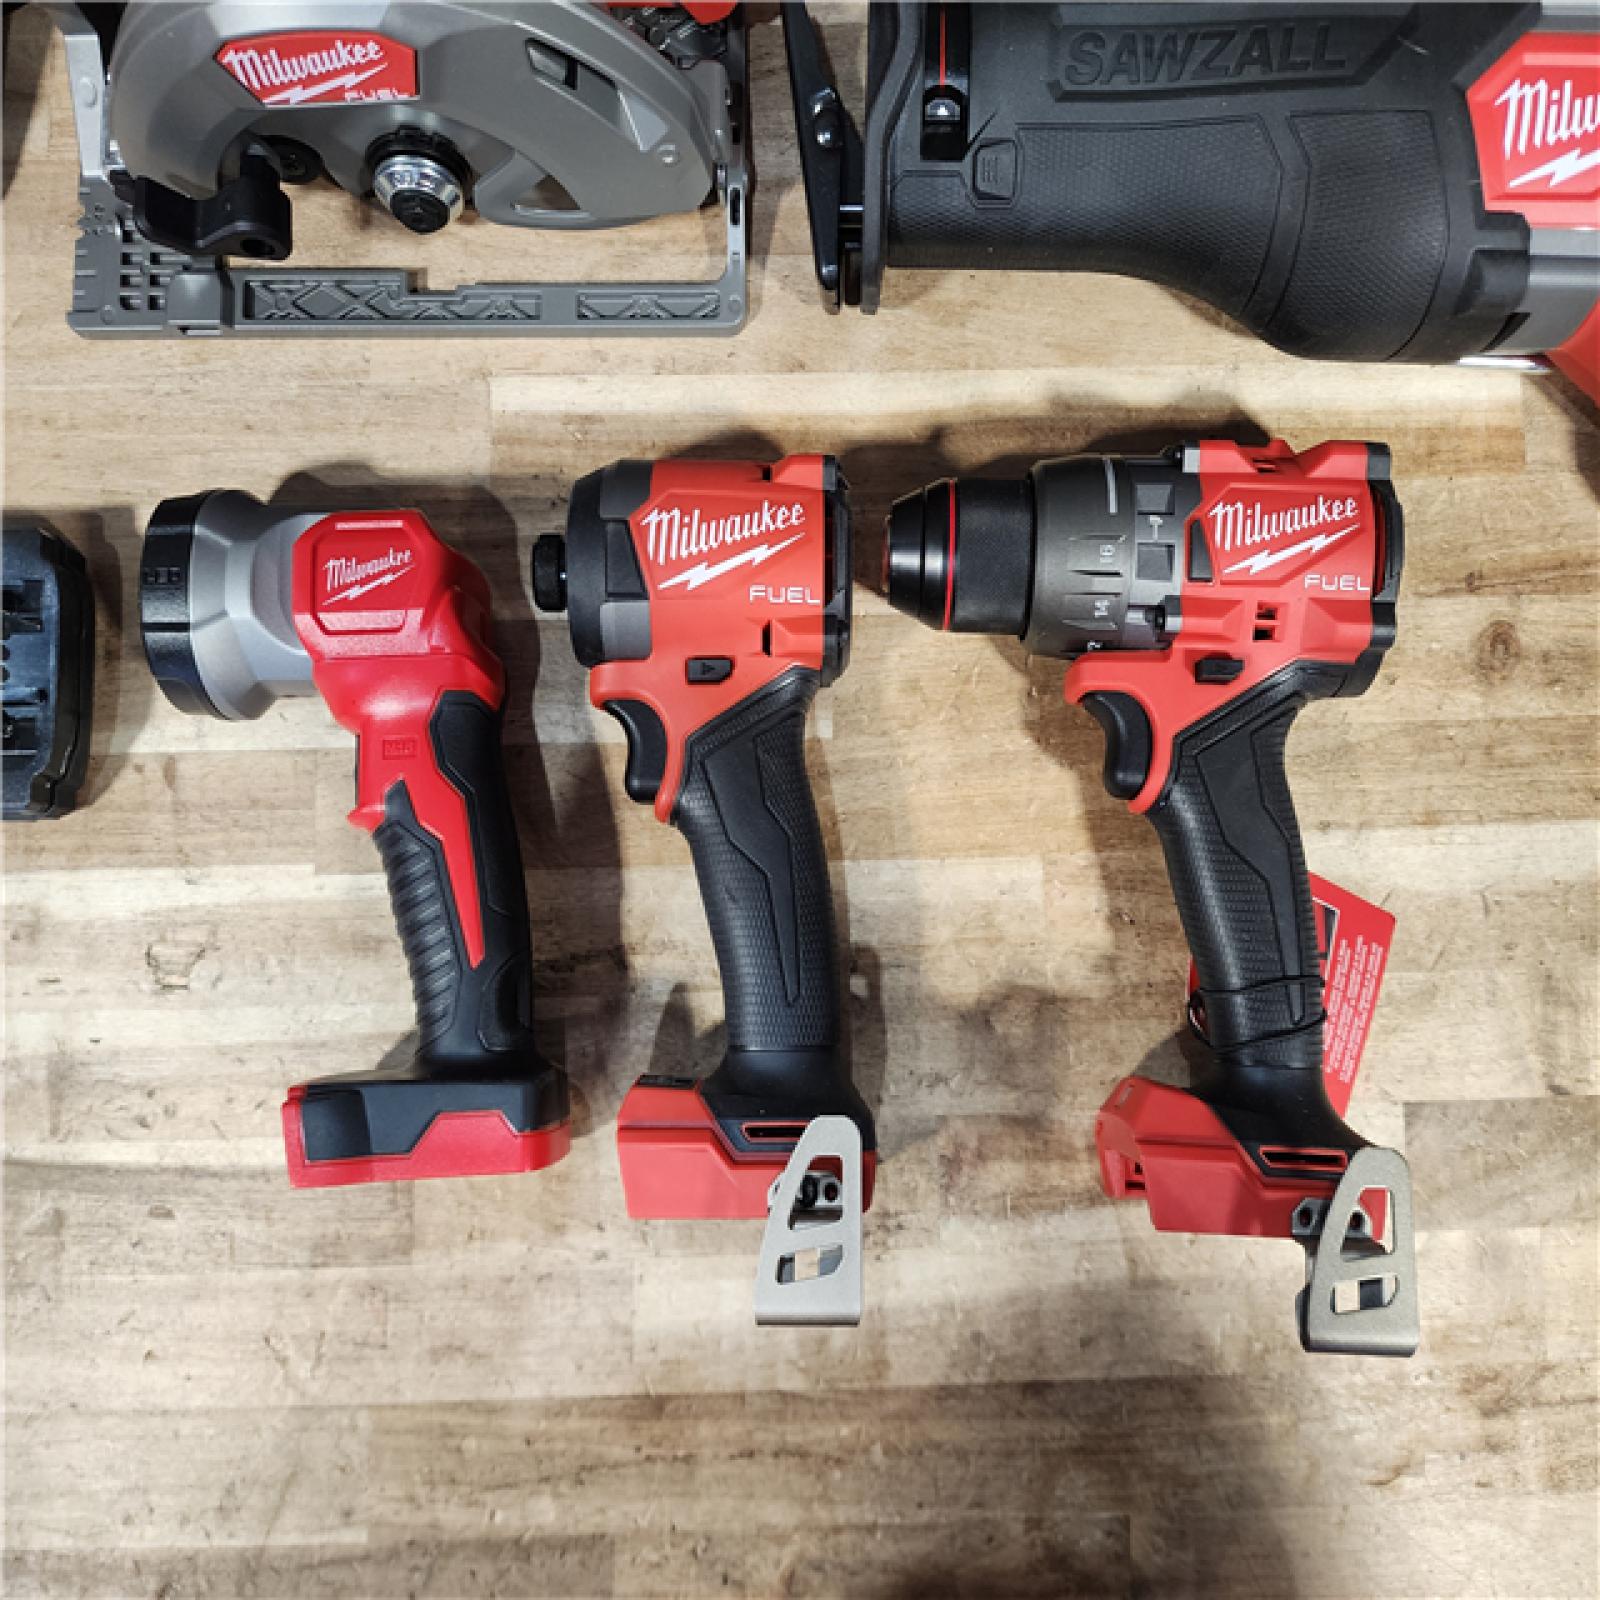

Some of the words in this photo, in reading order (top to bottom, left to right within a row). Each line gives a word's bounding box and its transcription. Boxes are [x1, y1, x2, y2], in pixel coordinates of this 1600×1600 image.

[222, 39, 384, 90] Milwaukee
[1064, 23, 1348, 86] SAWZALL
[640, 499, 806, 565] Milwaukee
[1208, 494, 1359, 552] Milwaukee
[322, 547, 412, 592] Milwaukee
[749, 585, 821, 604] FUEL
[1304, 574, 1370, 591] FUEL
